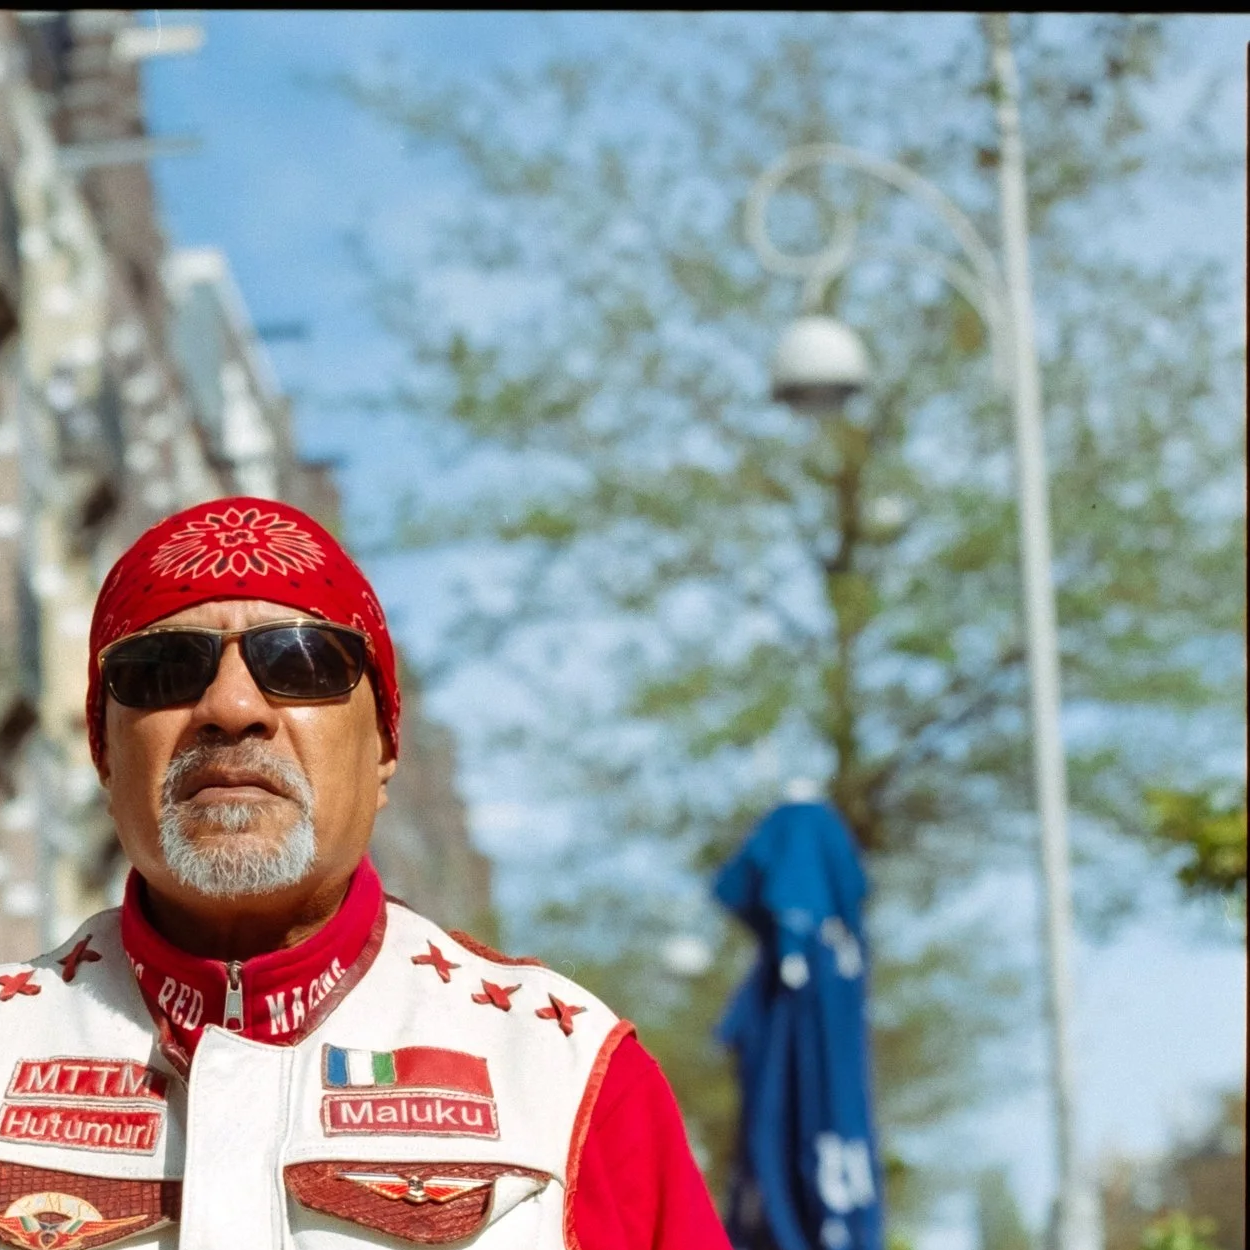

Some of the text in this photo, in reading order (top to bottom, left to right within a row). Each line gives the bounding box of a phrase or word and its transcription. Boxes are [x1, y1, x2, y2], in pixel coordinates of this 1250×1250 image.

[158, 976, 204, 1031] RED
[27, 1064, 151, 1095] MTTM
[5, 1111, 156, 1146] Hutumuri
[340, 1100, 484, 1126] Maluku
